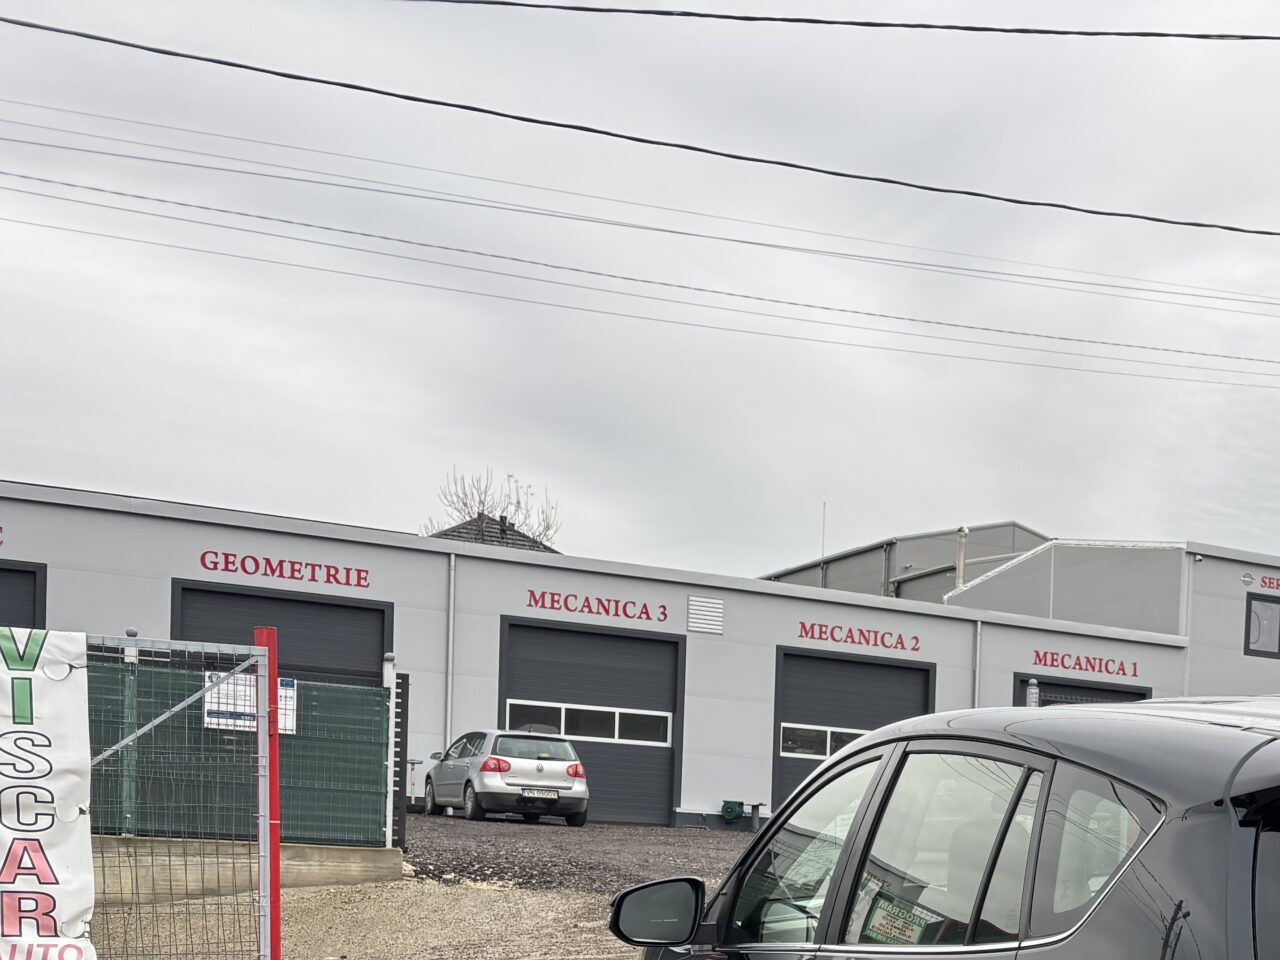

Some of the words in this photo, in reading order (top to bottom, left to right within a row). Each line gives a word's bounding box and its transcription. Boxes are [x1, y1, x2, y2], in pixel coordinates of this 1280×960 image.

[199, 550, 370, 588] GEOMETRIE
[526, 589, 652, 621] MECANICA
[657, 604, 668, 622] 3
[798, 621, 906, 650] MECANICA
[911, 635, 920, 651] 2
[1033, 650, 1127, 676] MECANICA
[1131, 661, 1138, 677] 1
